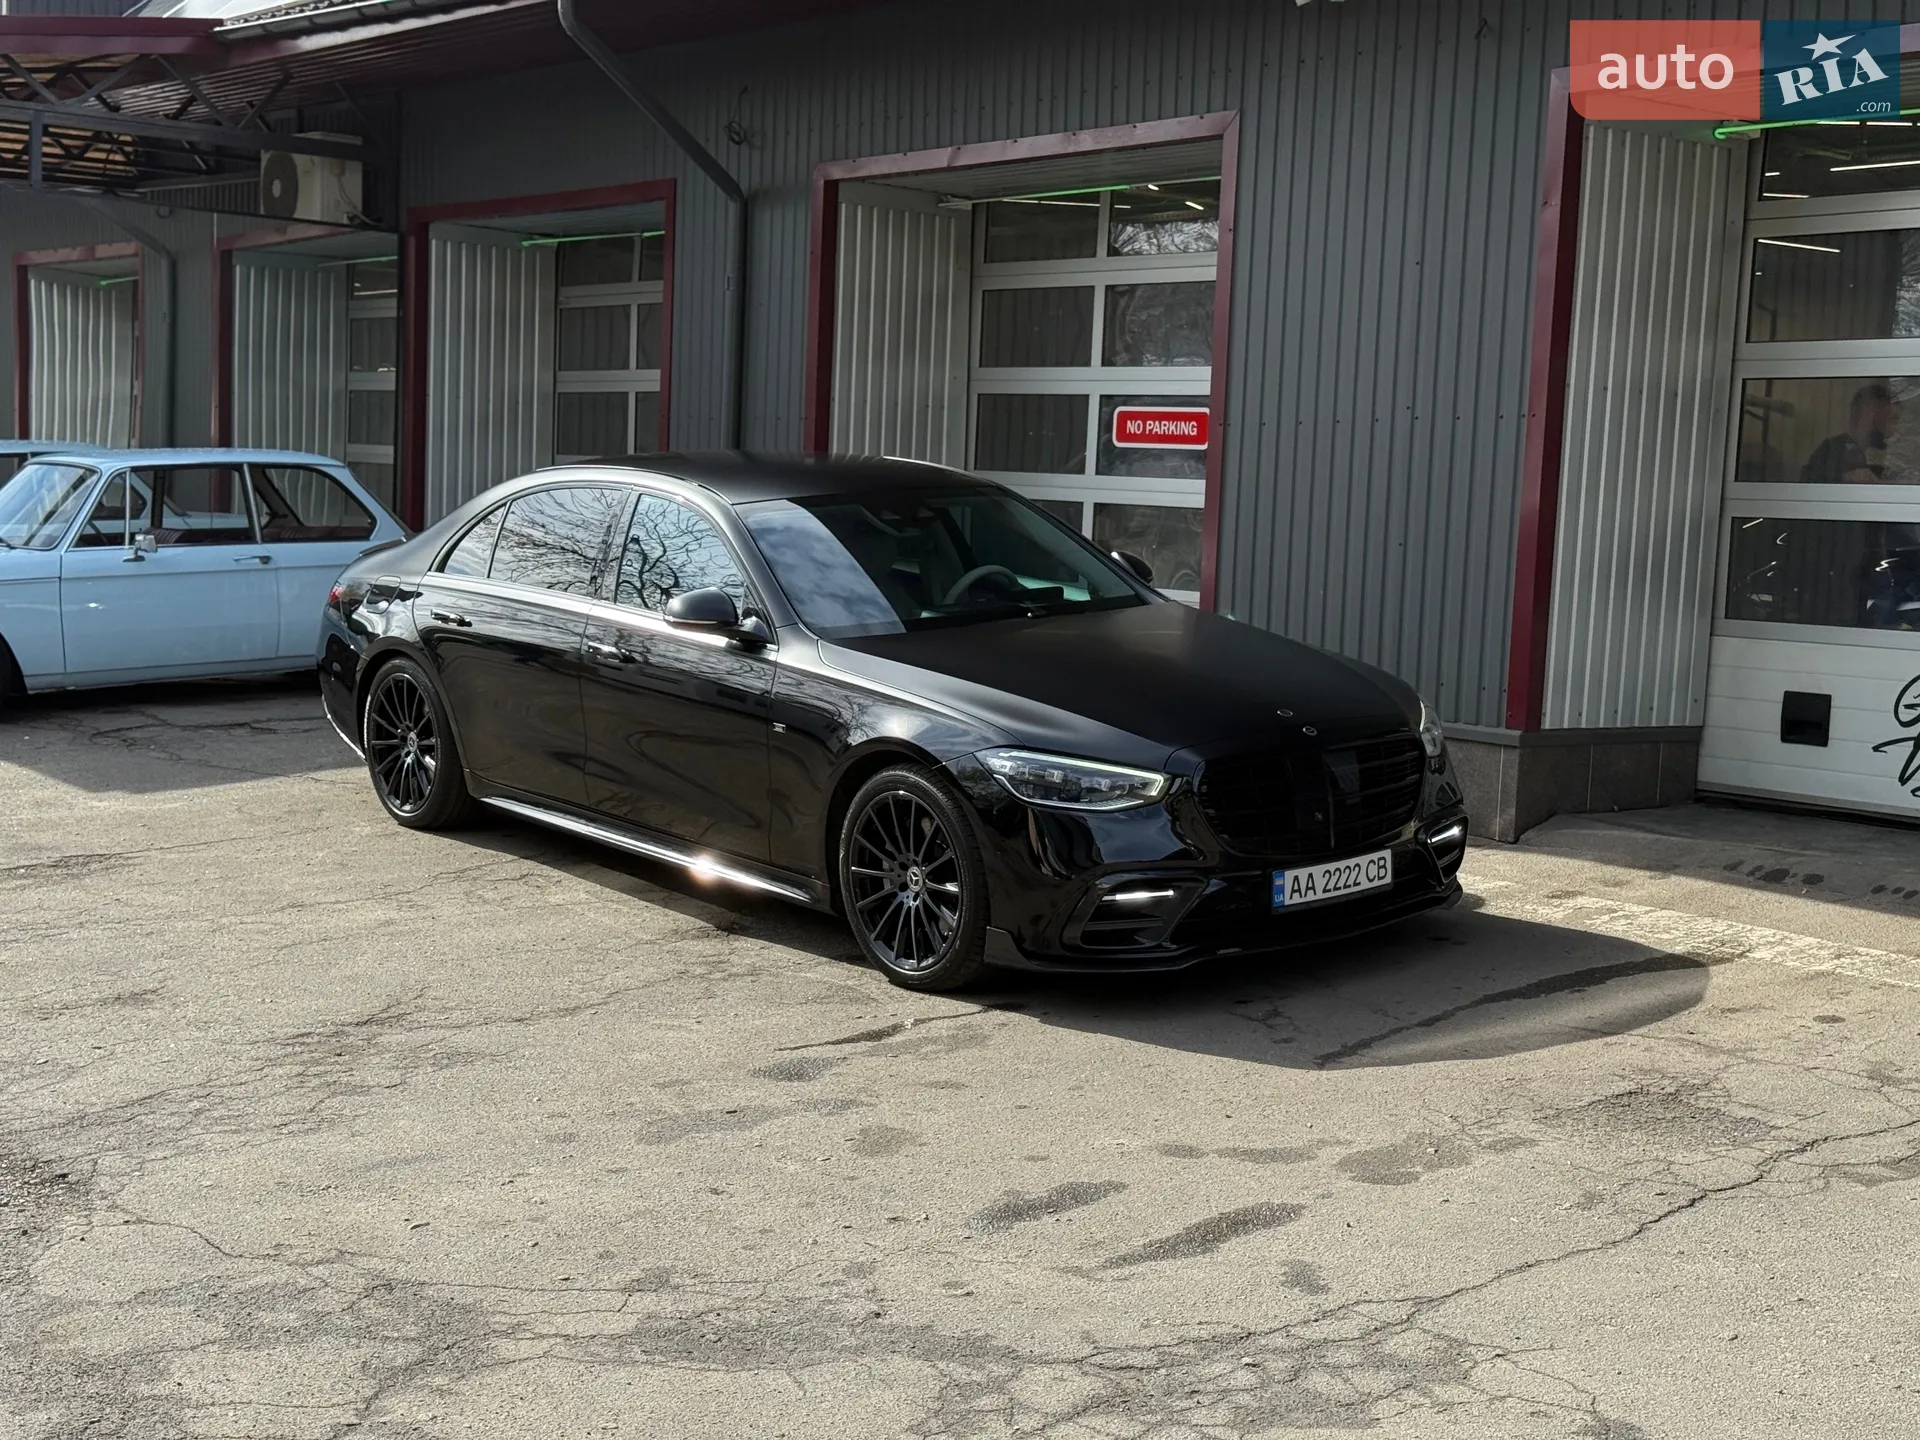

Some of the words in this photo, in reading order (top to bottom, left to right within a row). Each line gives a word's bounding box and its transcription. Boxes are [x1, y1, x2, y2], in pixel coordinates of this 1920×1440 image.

[1126, 420, 1143, 435] NO
[1146, 421, 1198, 436] PARKING
[1289, 872, 1317, 900] AA
[1322, 863, 1362, 894] 2222
[1366, 856, 1388, 883] CB
[1274, 894, 1284, 903] UA
